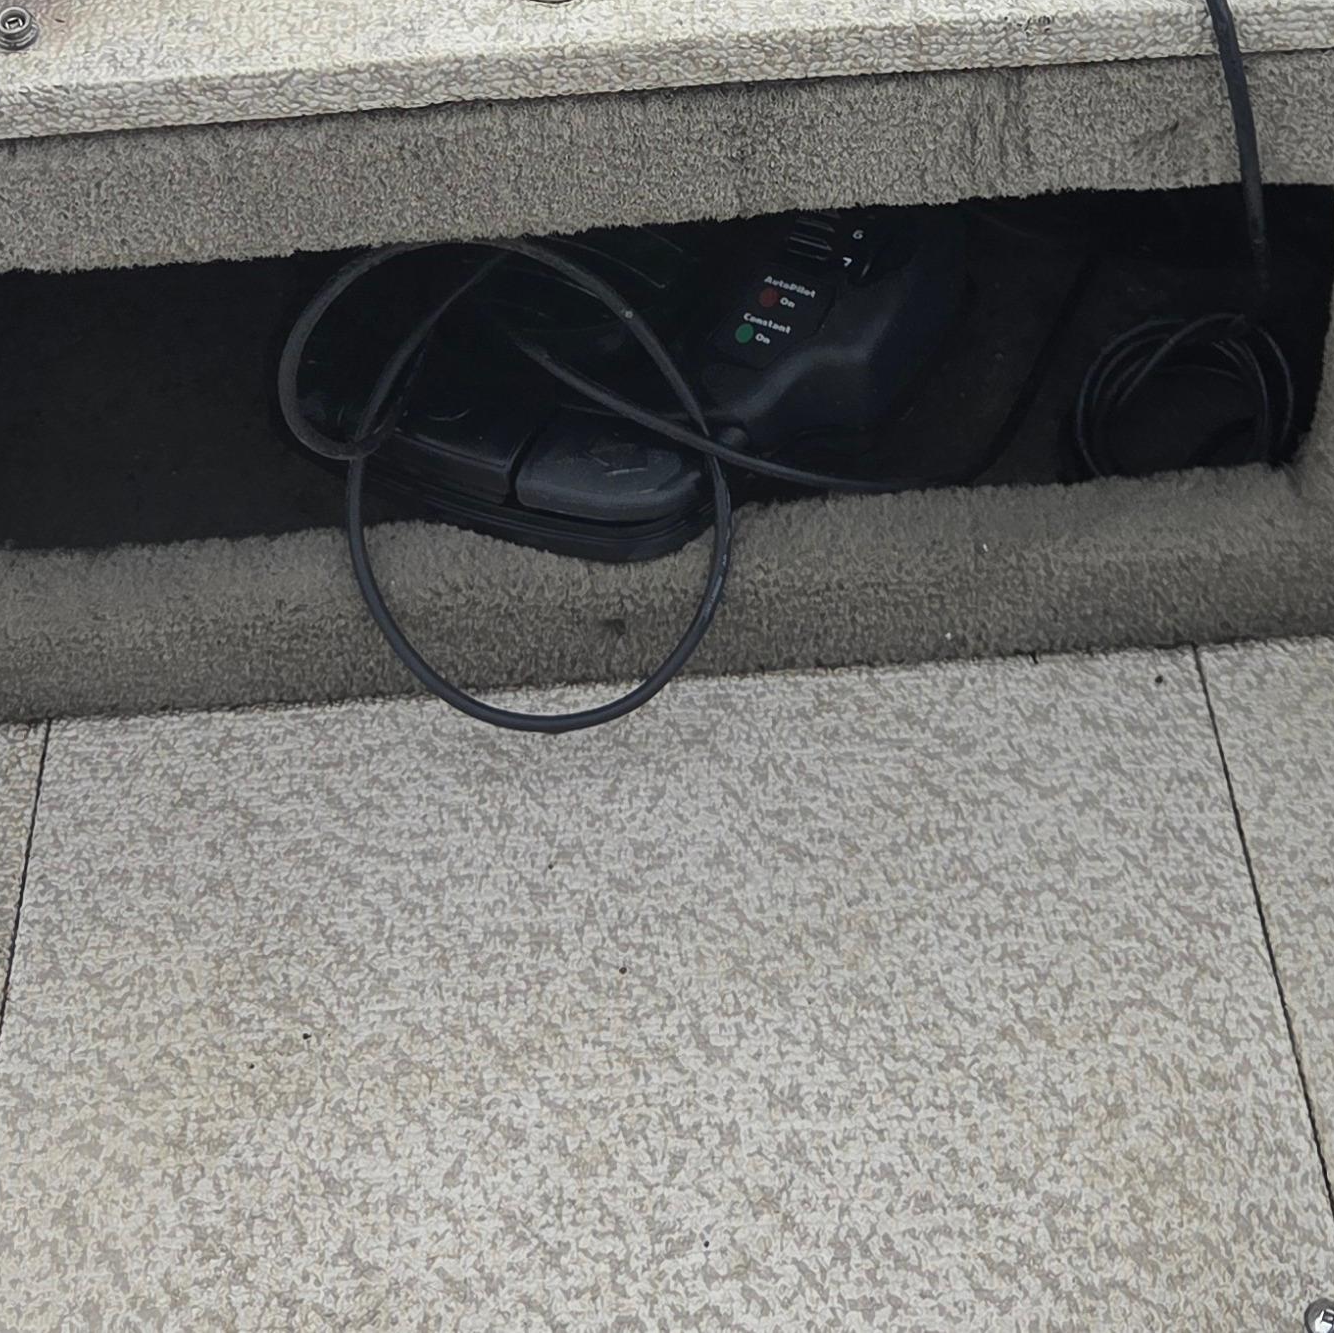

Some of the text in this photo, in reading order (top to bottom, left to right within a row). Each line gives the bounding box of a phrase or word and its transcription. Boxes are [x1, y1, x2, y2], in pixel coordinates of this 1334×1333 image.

[852, 229, 865, 240] 6
[842, 256, 853, 267] 7
[763, 275, 817, 299] AutoPilot
[779, 296, 796, 309] On
[742, 312, 792, 335] Constant
[754, 333, 771, 345] On
